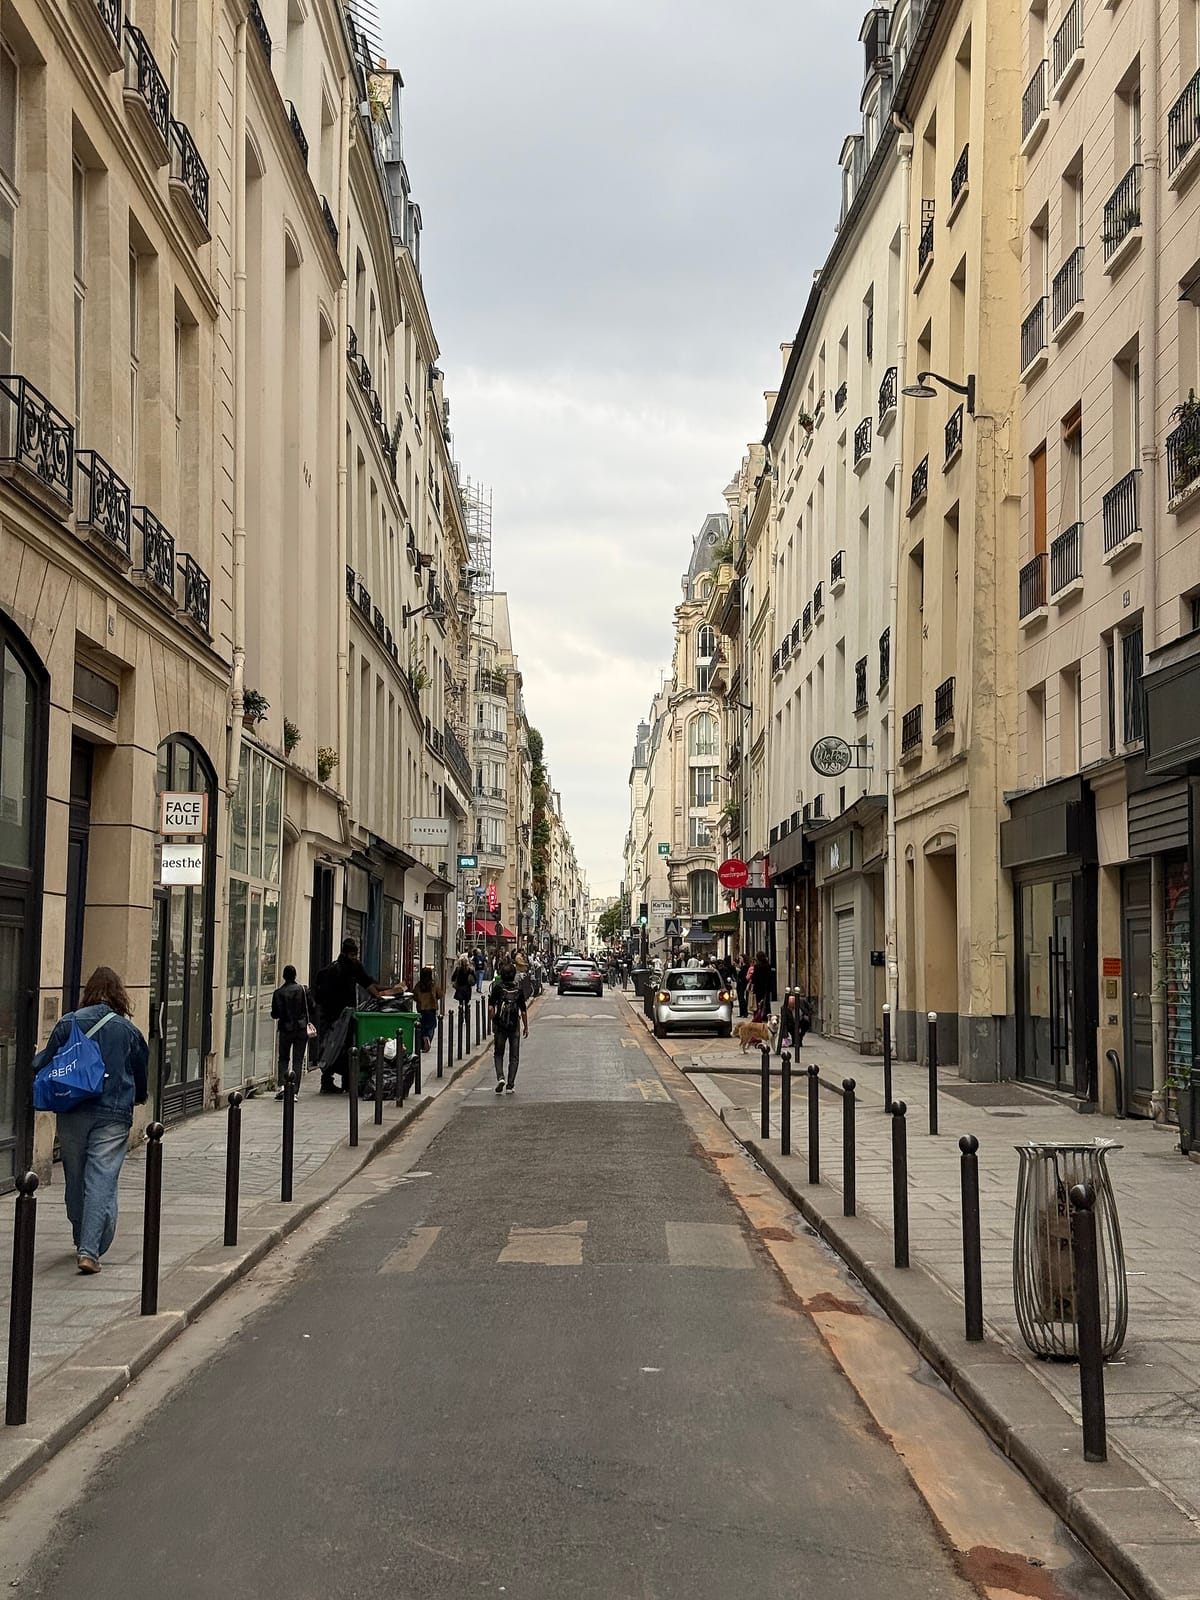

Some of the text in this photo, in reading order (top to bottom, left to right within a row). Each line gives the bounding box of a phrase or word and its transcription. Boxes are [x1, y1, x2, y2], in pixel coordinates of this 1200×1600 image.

[166, 802, 200, 812] FACE
[165, 814, 200, 825] KULT
[162, 857, 202, 868] aesthé
